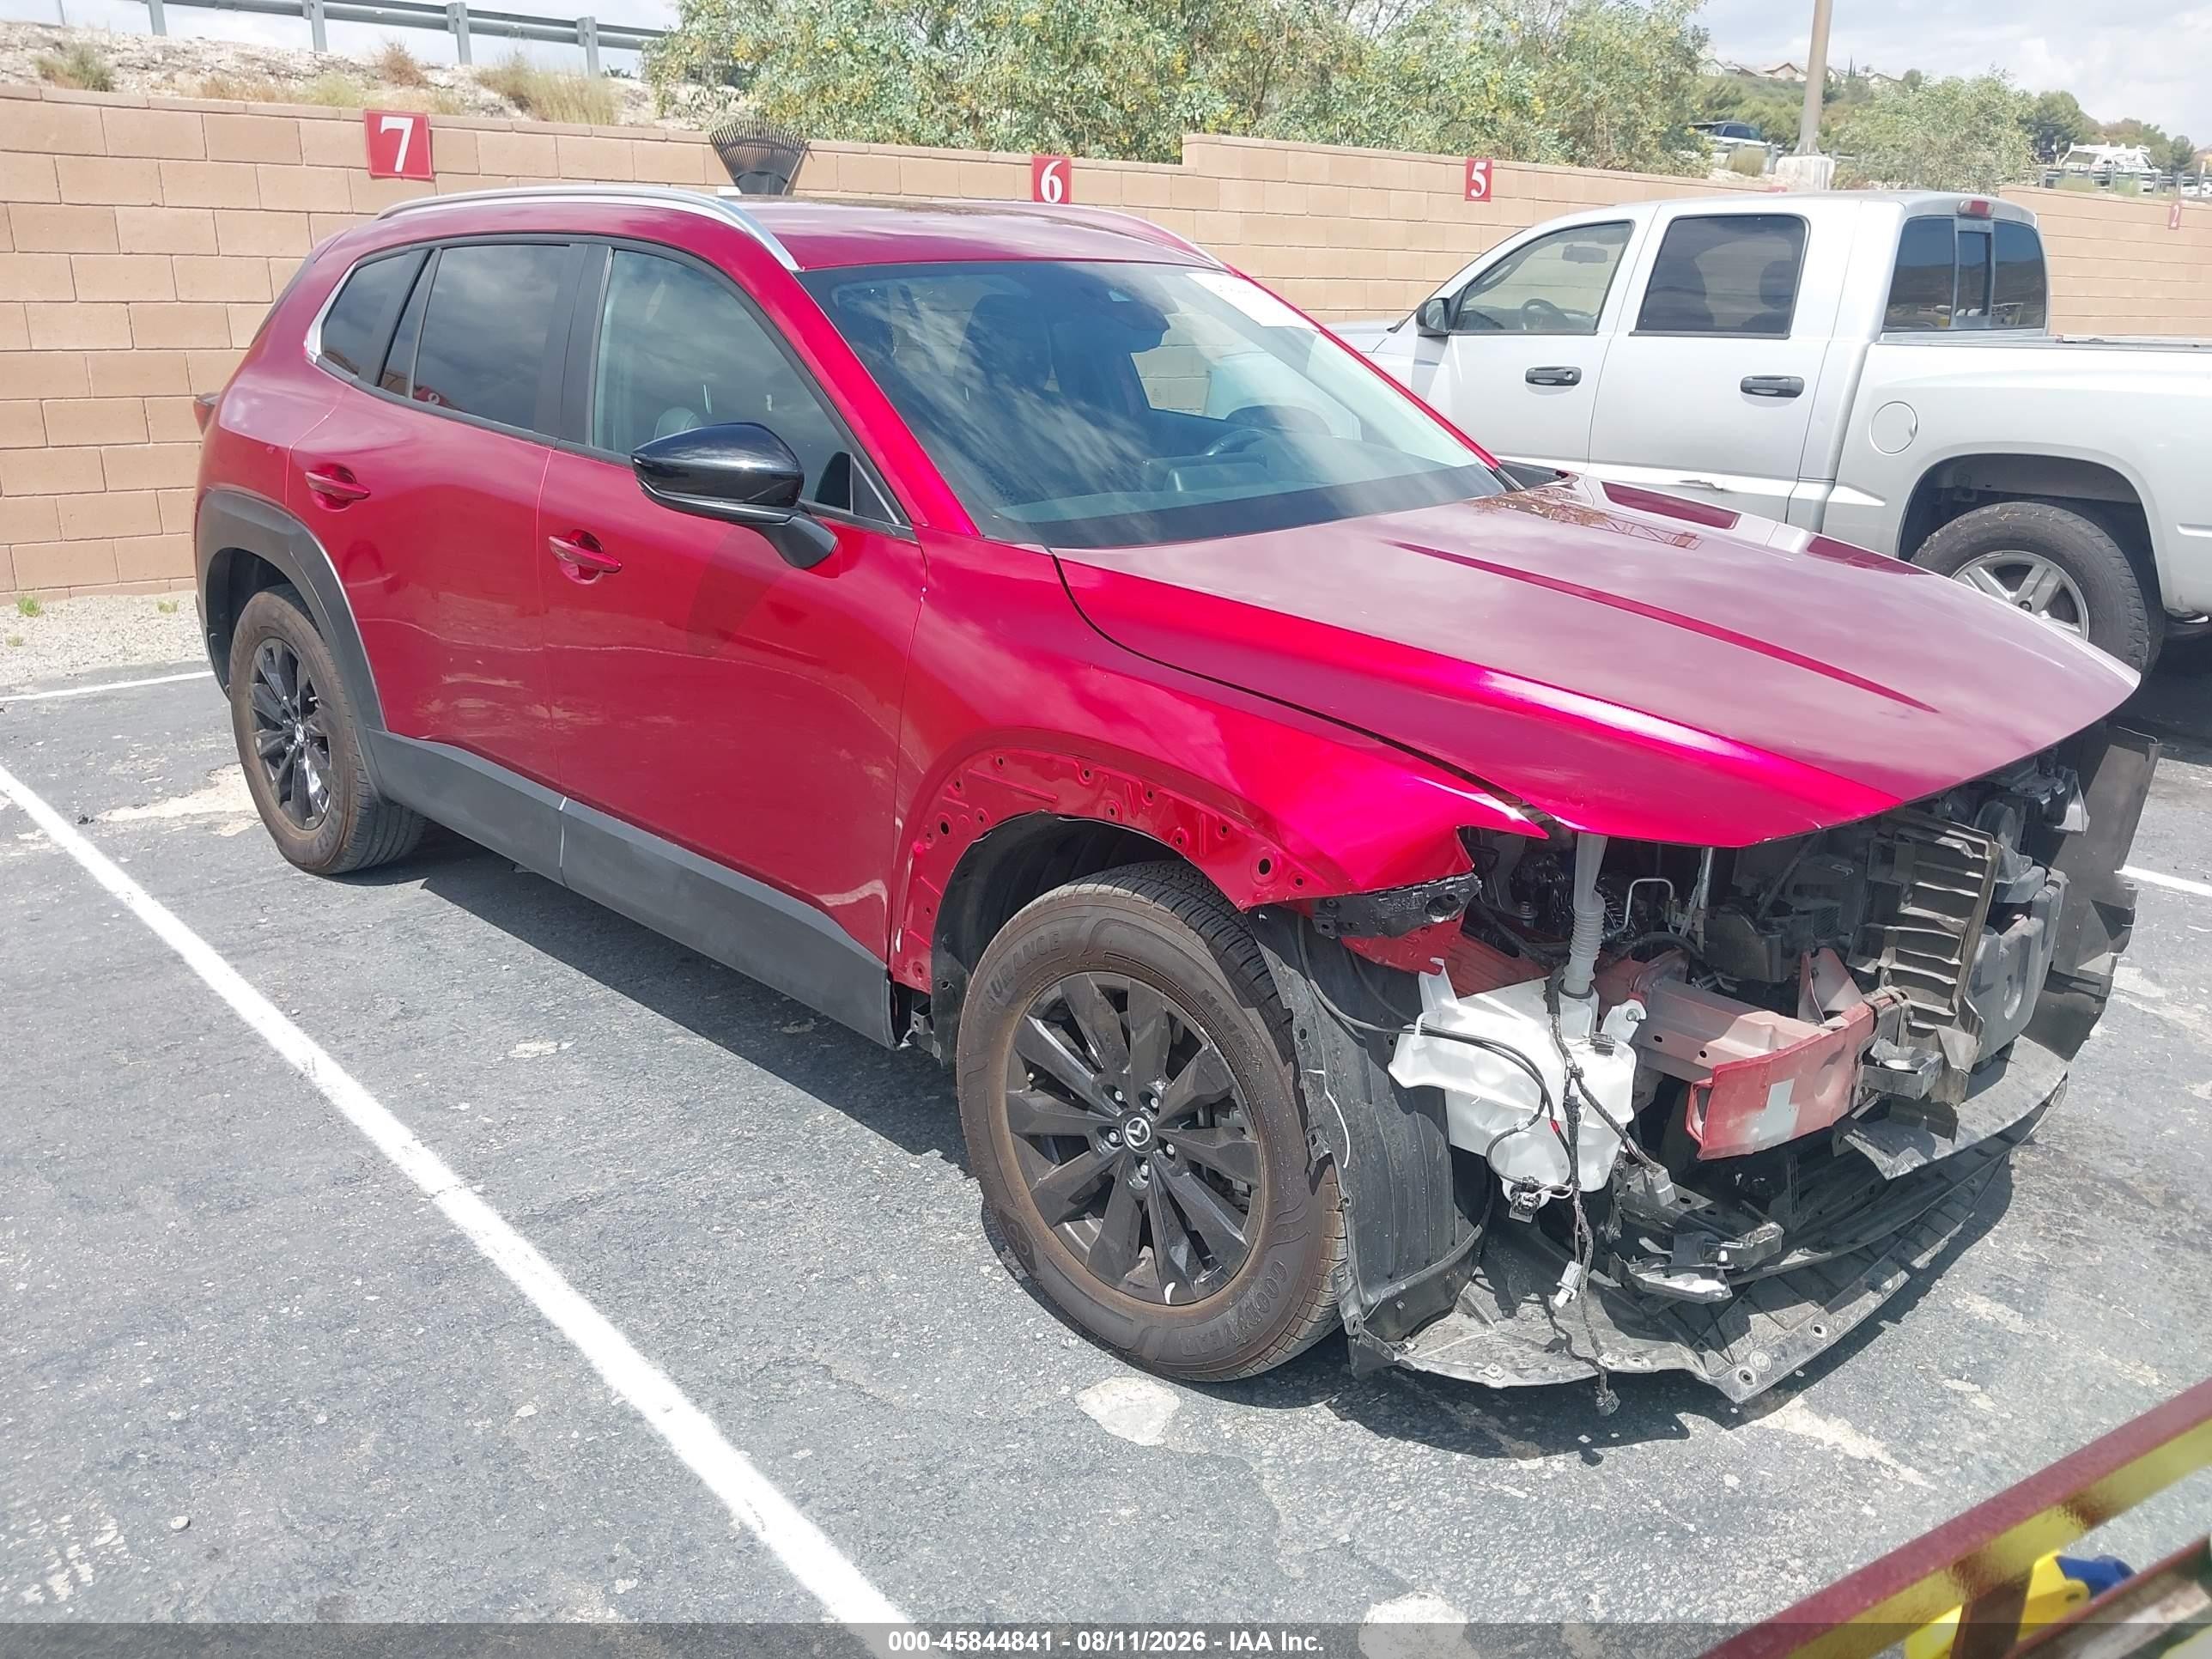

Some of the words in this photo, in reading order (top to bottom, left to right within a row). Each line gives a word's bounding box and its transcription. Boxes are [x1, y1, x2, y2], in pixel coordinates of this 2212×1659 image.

[380, 116, 414, 173] 7
[1040, 160, 1063, 204] 6
[1470, 161, 1487, 198] 5
[2170, 204, 2179, 228] 2
